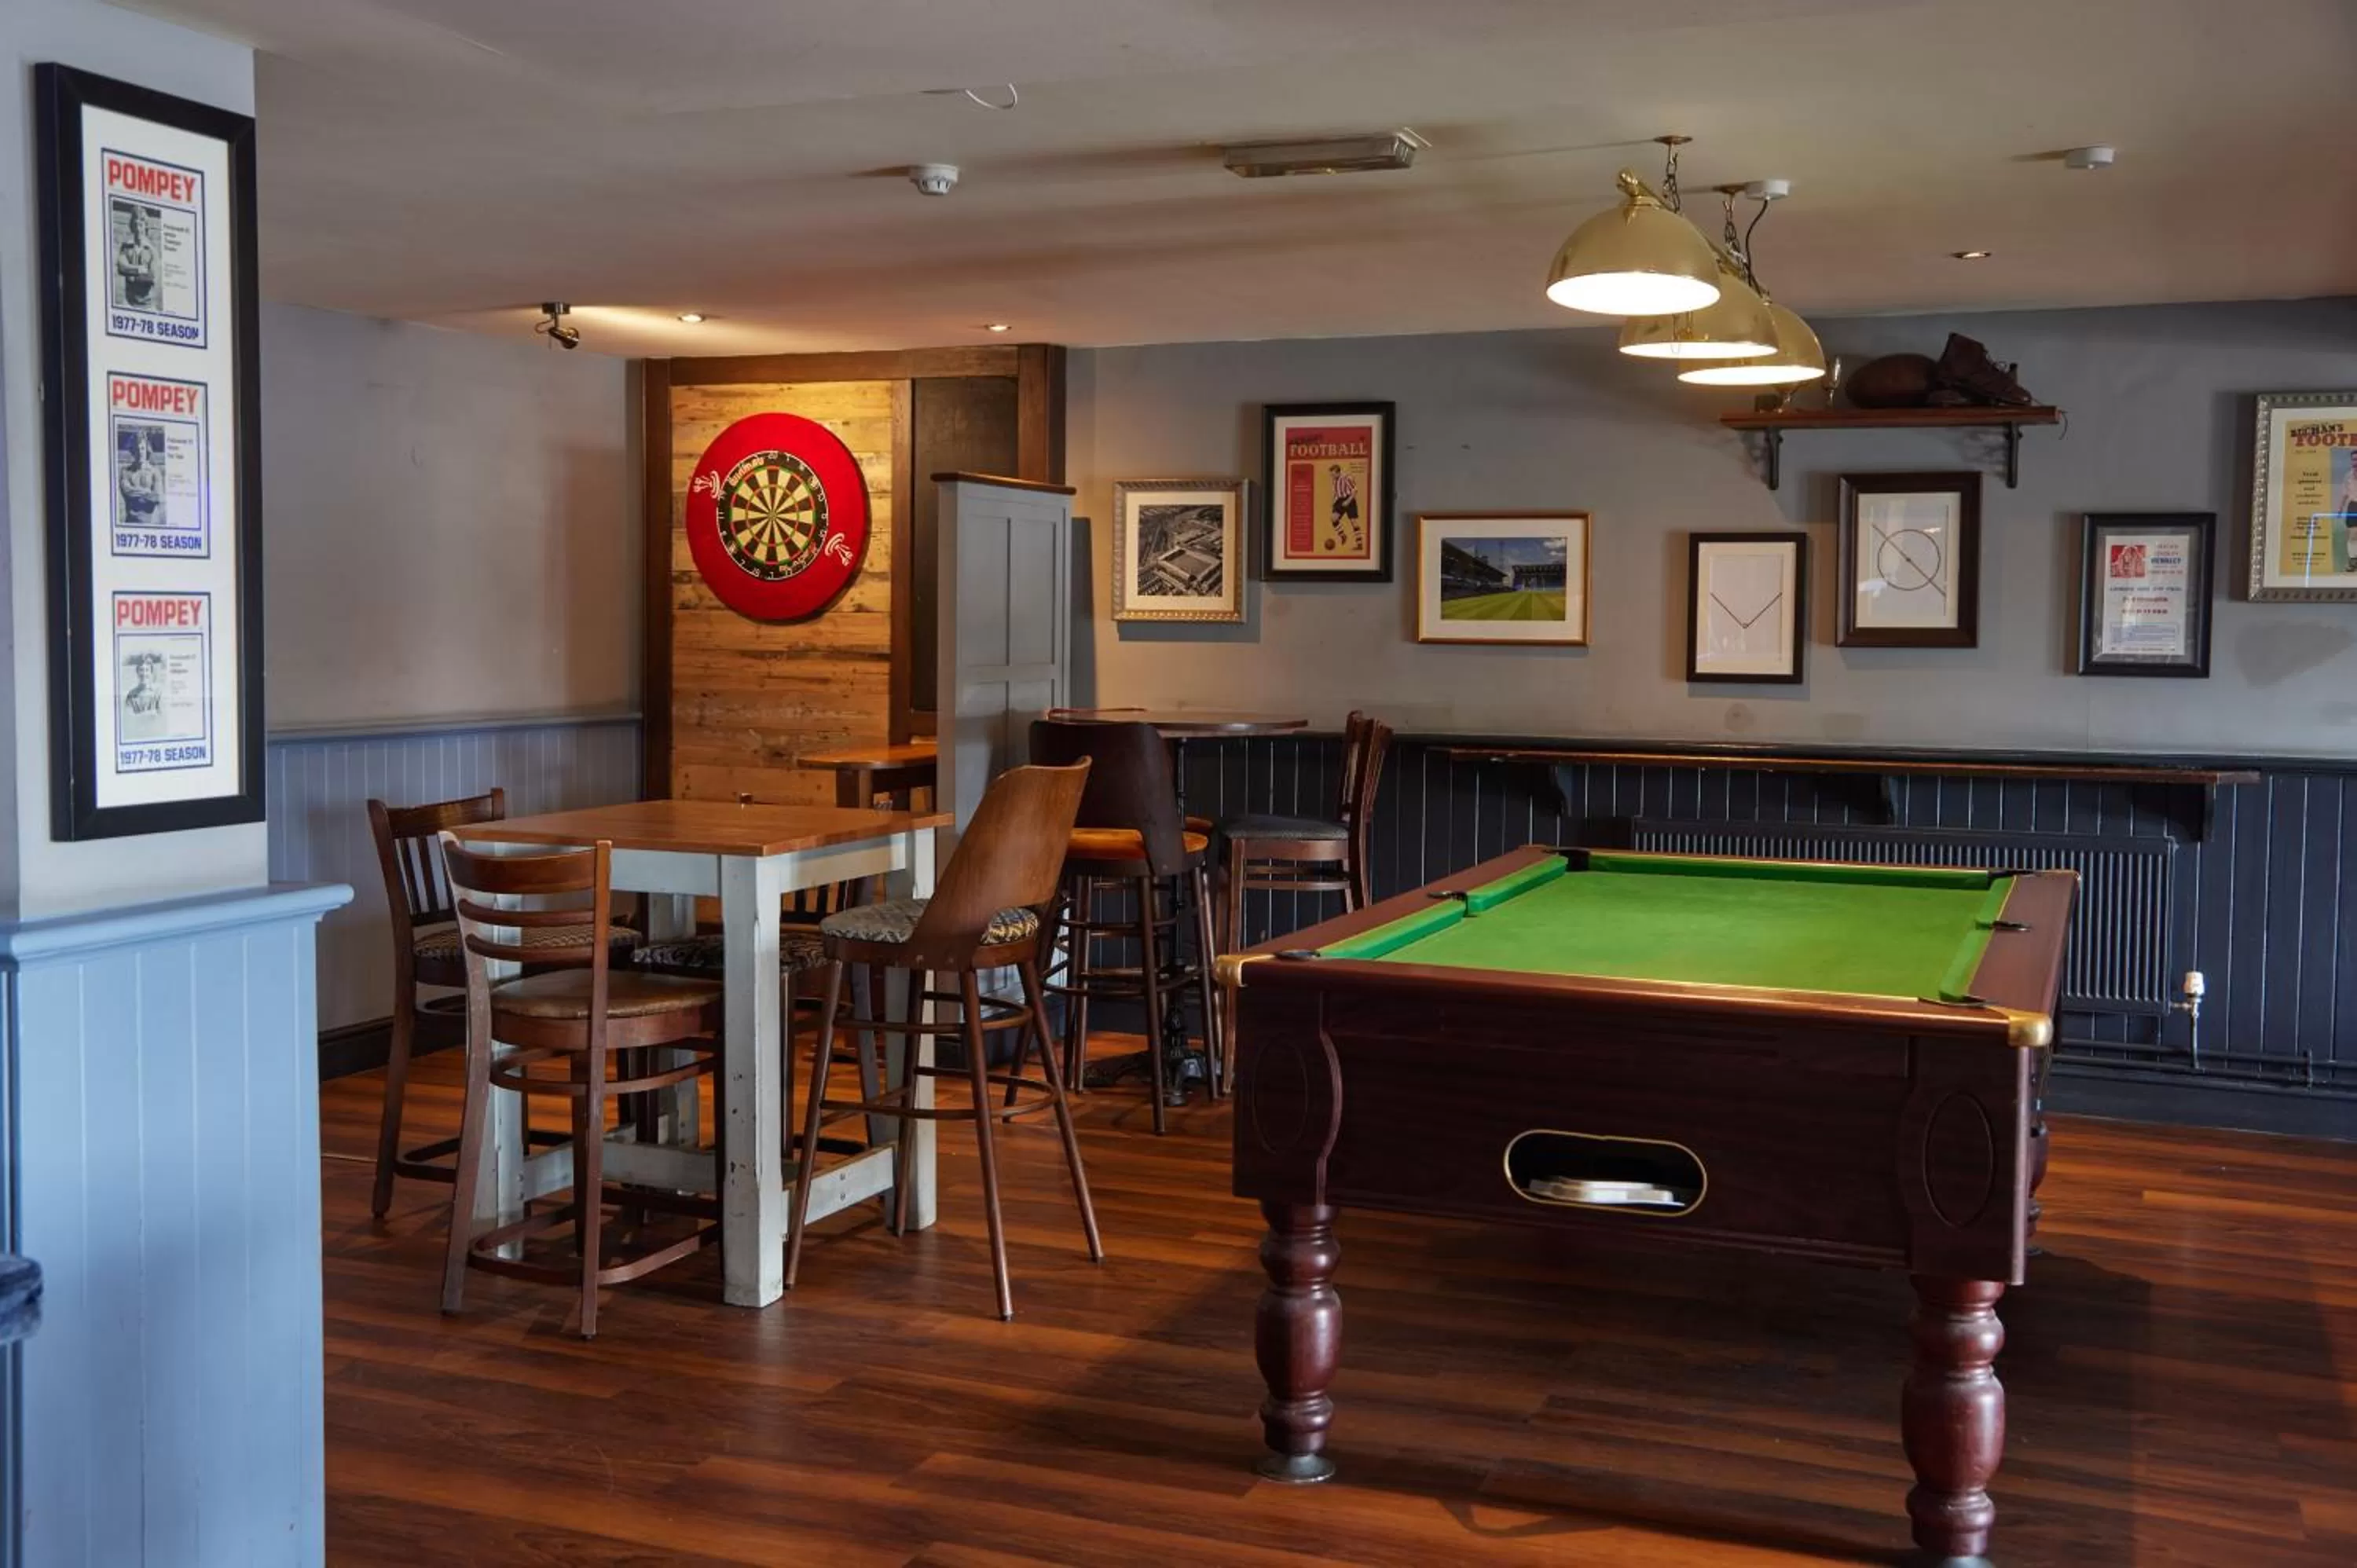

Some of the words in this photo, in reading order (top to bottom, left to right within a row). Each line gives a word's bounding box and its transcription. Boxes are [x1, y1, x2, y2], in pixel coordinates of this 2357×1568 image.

[108, 159, 196, 203] POMPEY
[112, 314, 155, 335] 1977-78
[156, 321, 200, 340] SEASON
[112, 379, 198, 415] POMPEY
[1288, 441, 1368, 457] FOOTBALL
[115, 533, 157, 548] 1977-78
[160, 535, 202, 550] SEASON
[117, 599, 202, 627] POMPEY
[119, 749, 162, 765] 1977-78
[164, 746, 207, 762] SEASON
